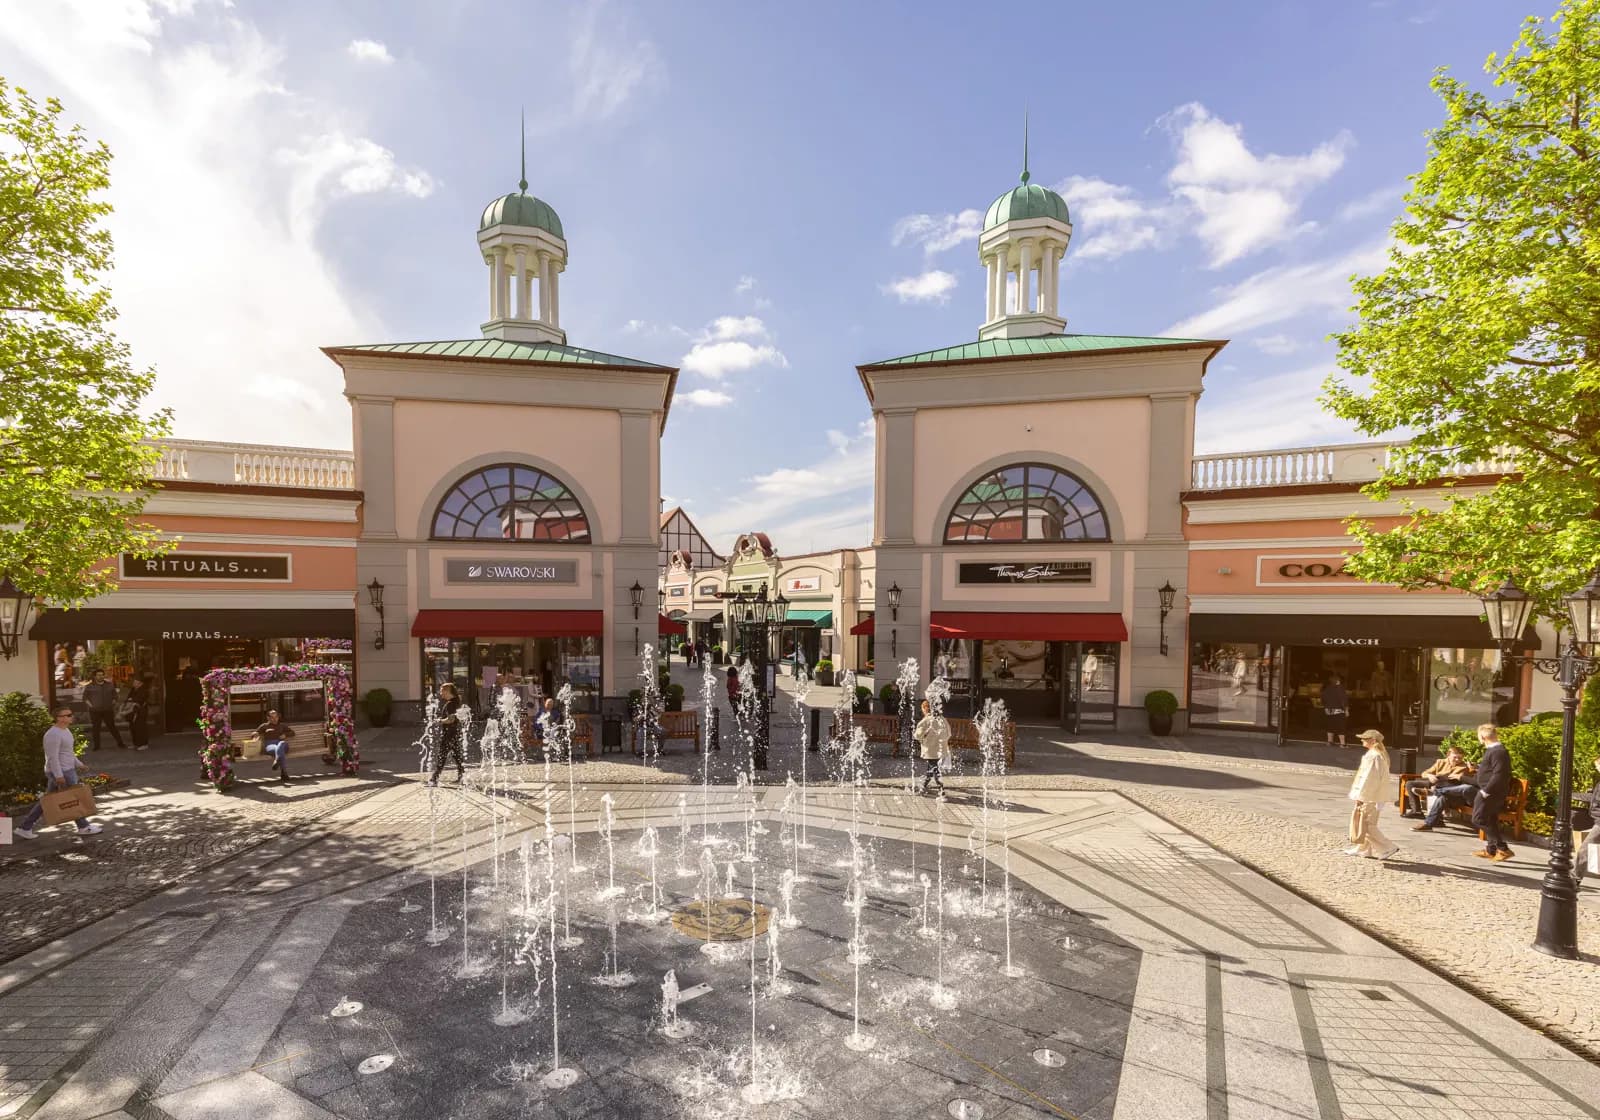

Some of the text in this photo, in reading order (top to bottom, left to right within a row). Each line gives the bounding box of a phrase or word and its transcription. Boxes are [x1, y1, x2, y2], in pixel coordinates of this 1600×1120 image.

[145, 560, 268, 573] RITUALS...
[486, 566, 555, 578] SWAROVSKI
[989, 565, 1060, 579] Thomas Sabo
[1279, 563, 1357, 578] COA
[162, 631, 239, 639] RITUALS...
[1322, 637, 1379, 646] COACH
